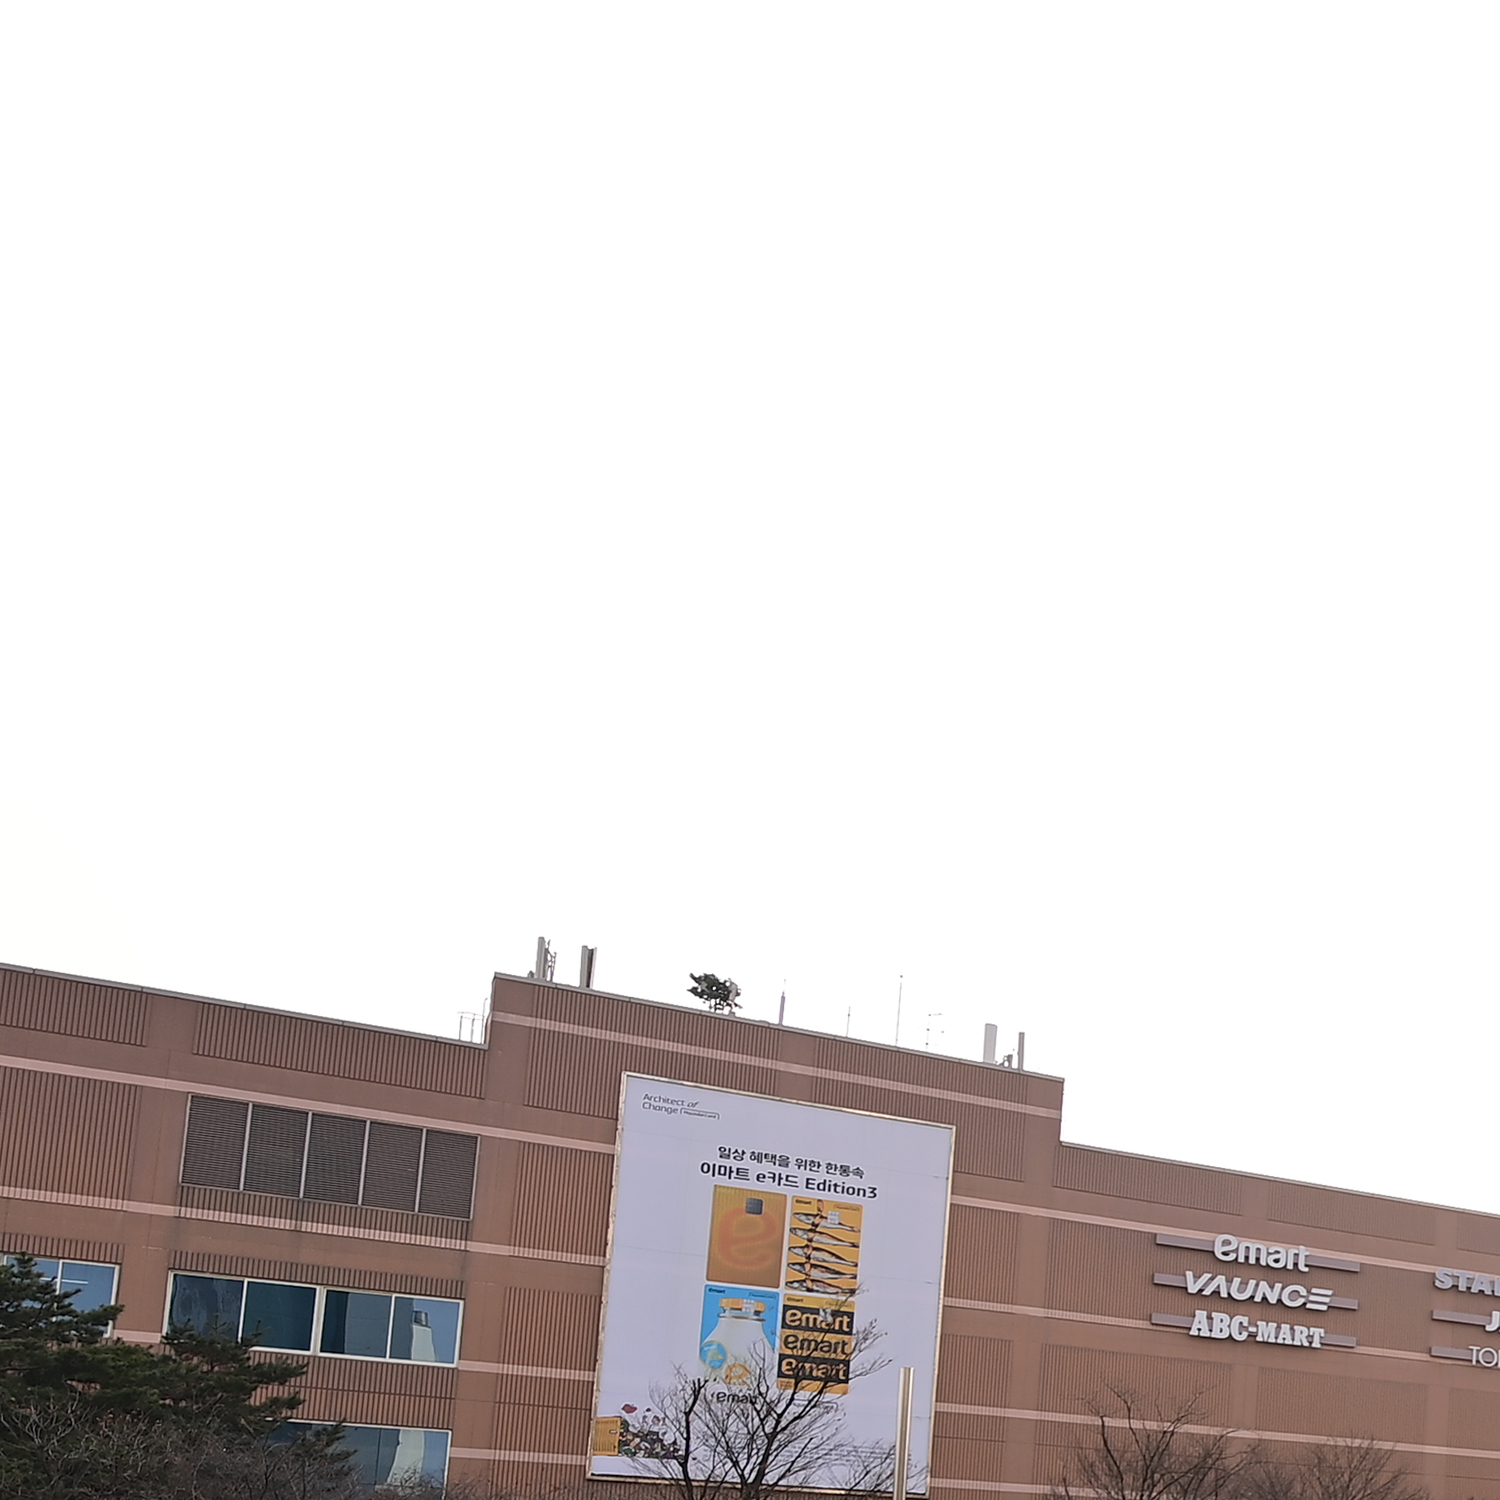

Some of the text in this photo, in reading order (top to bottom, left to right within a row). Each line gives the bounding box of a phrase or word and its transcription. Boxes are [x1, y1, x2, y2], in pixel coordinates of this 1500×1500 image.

[642, 1102, 678, 1114] Change
[643, 1093, 685, 1107] Architect
[718, 1146, 865, 1180] 일상 혜택을 위한 한통속
[700, 1162, 878, 1199] 이마트 e카드 Edition3
[1213, 1234, 1310, 1273] emart
[783, 1334, 849, 1356] emart
[1189, 1310, 1324, 1348] ABC-MART
